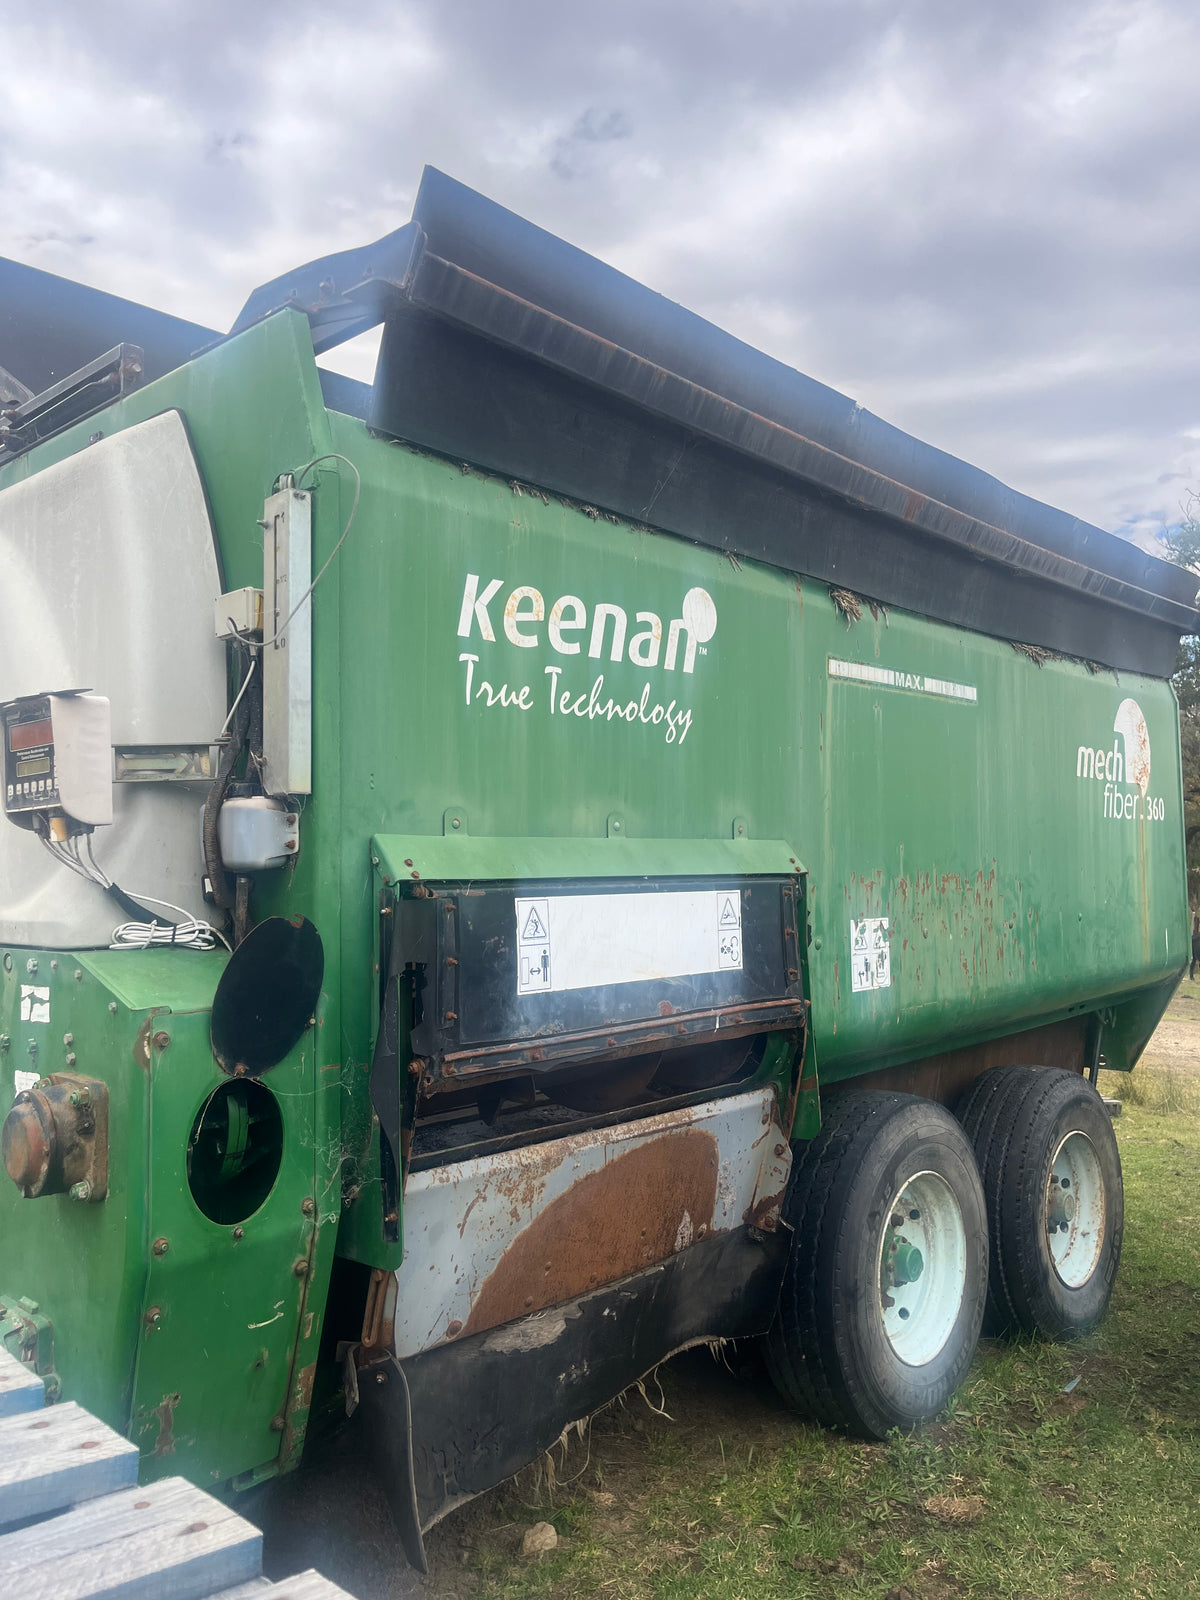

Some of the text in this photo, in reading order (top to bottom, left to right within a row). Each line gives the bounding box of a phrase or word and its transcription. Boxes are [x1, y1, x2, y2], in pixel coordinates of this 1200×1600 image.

[457, 573, 702, 674] Keenan
[458, 653, 693, 744] True Technology
[895, 671, 924, 691] MAX.
[1076, 739, 1123, 782] mech
